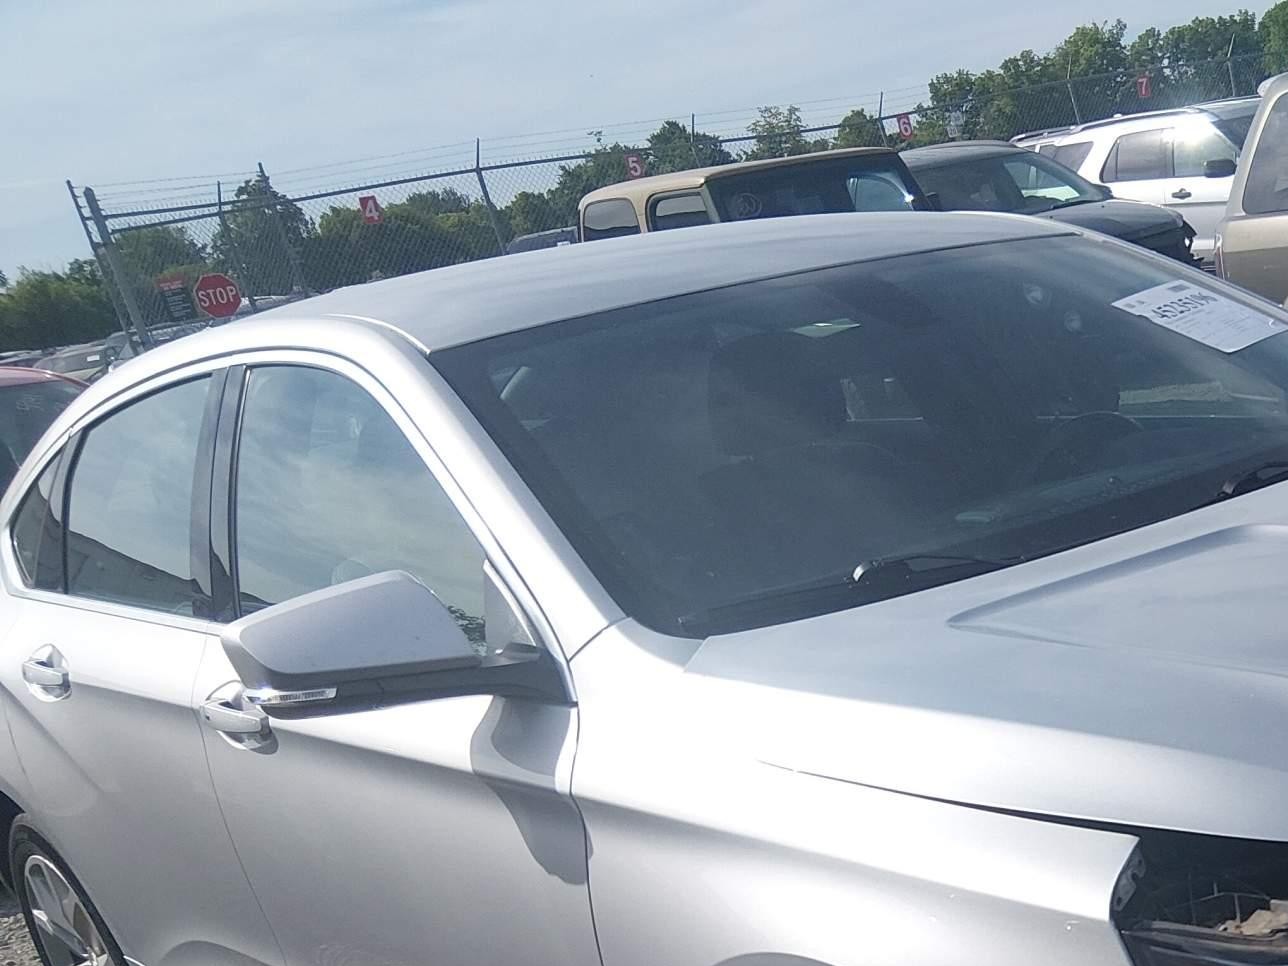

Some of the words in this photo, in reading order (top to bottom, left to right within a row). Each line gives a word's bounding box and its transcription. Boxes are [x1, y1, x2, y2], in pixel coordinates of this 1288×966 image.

[1137, 77, 1147, 95] 7
[899, 117, 912, 137] 6
[628, 157, 641, 176] 5
[365, 199, 380, 220] 4
[197, 285, 237, 307] STOP
